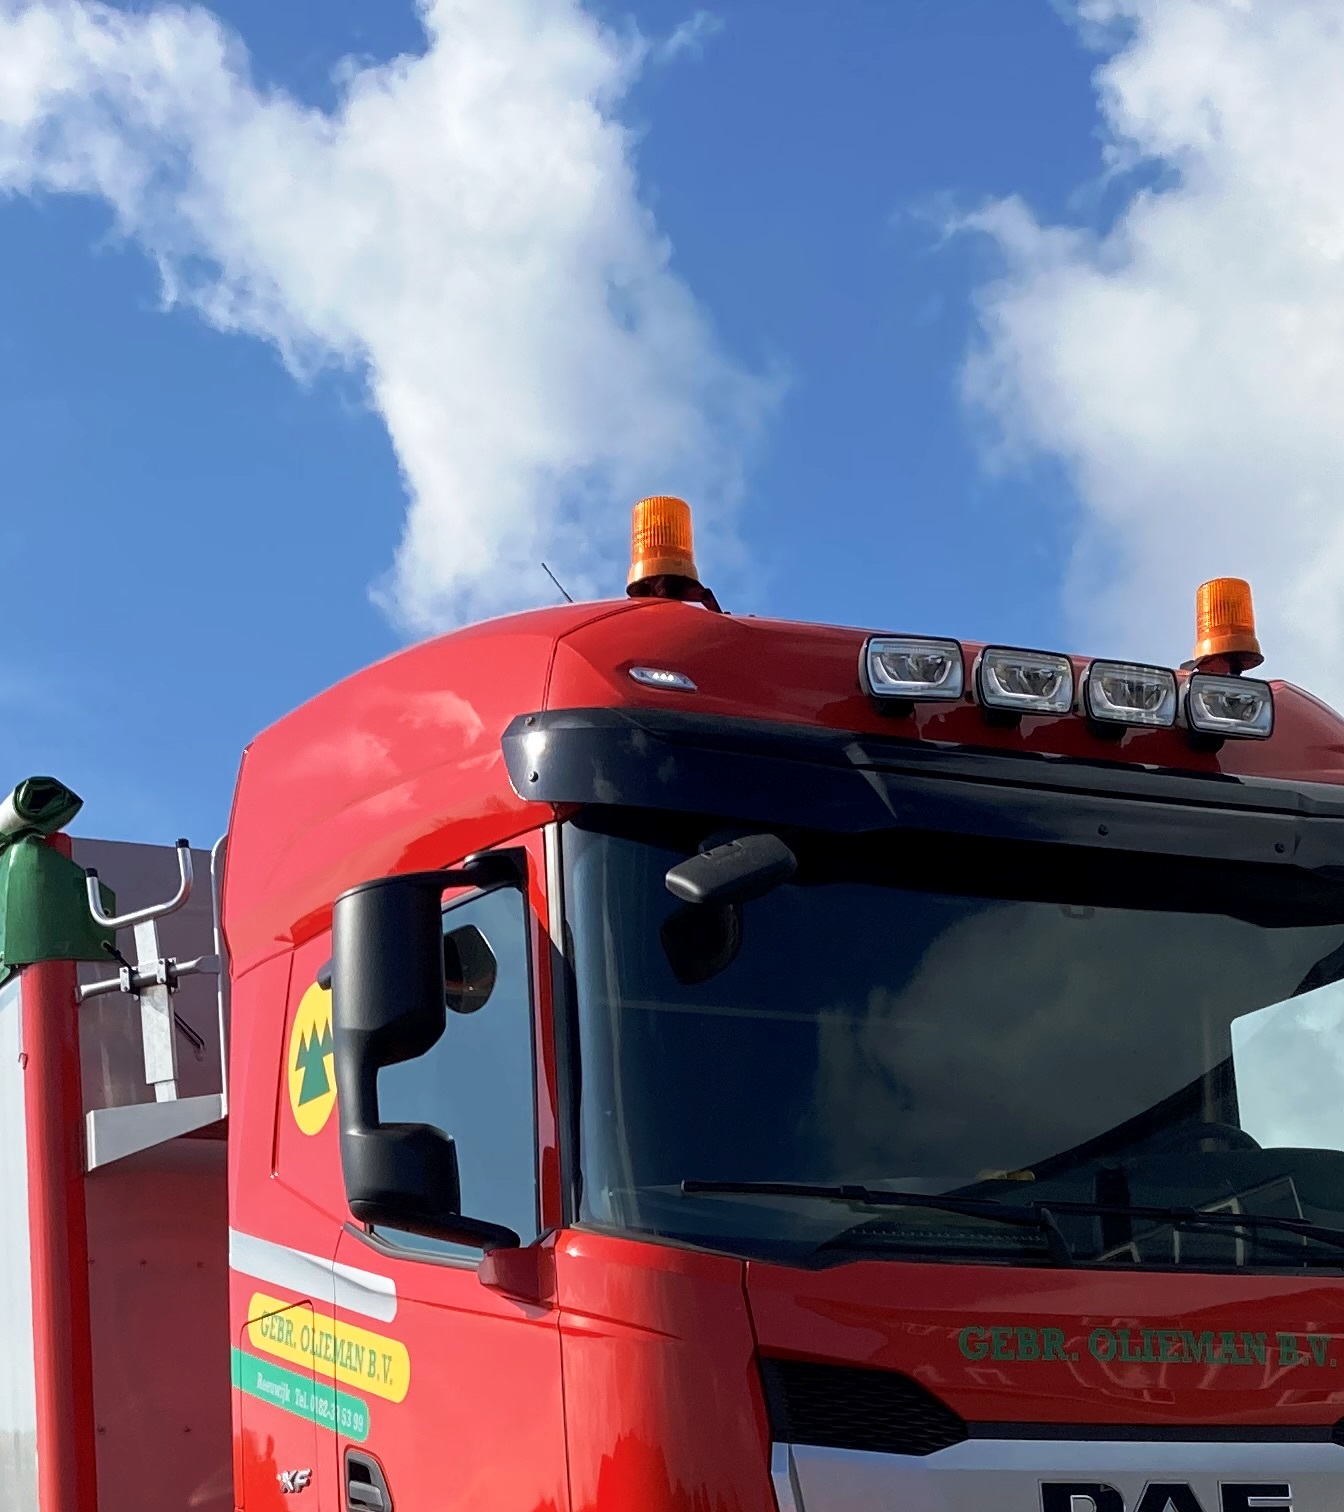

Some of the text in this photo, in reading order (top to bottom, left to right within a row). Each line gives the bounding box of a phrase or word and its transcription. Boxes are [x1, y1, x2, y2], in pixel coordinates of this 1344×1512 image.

[260, 1310, 297, 1349] GEBR.
[300, 1325, 365, 1374] OLIEMAN
[958, 1326, 1338, 1369] GEBR. OLIEMAN B.V.
[341, 1408, 352, 1428] 53
[353, 1412, 364, 1433] 99
[276, 1468, 312, 1493] XF
